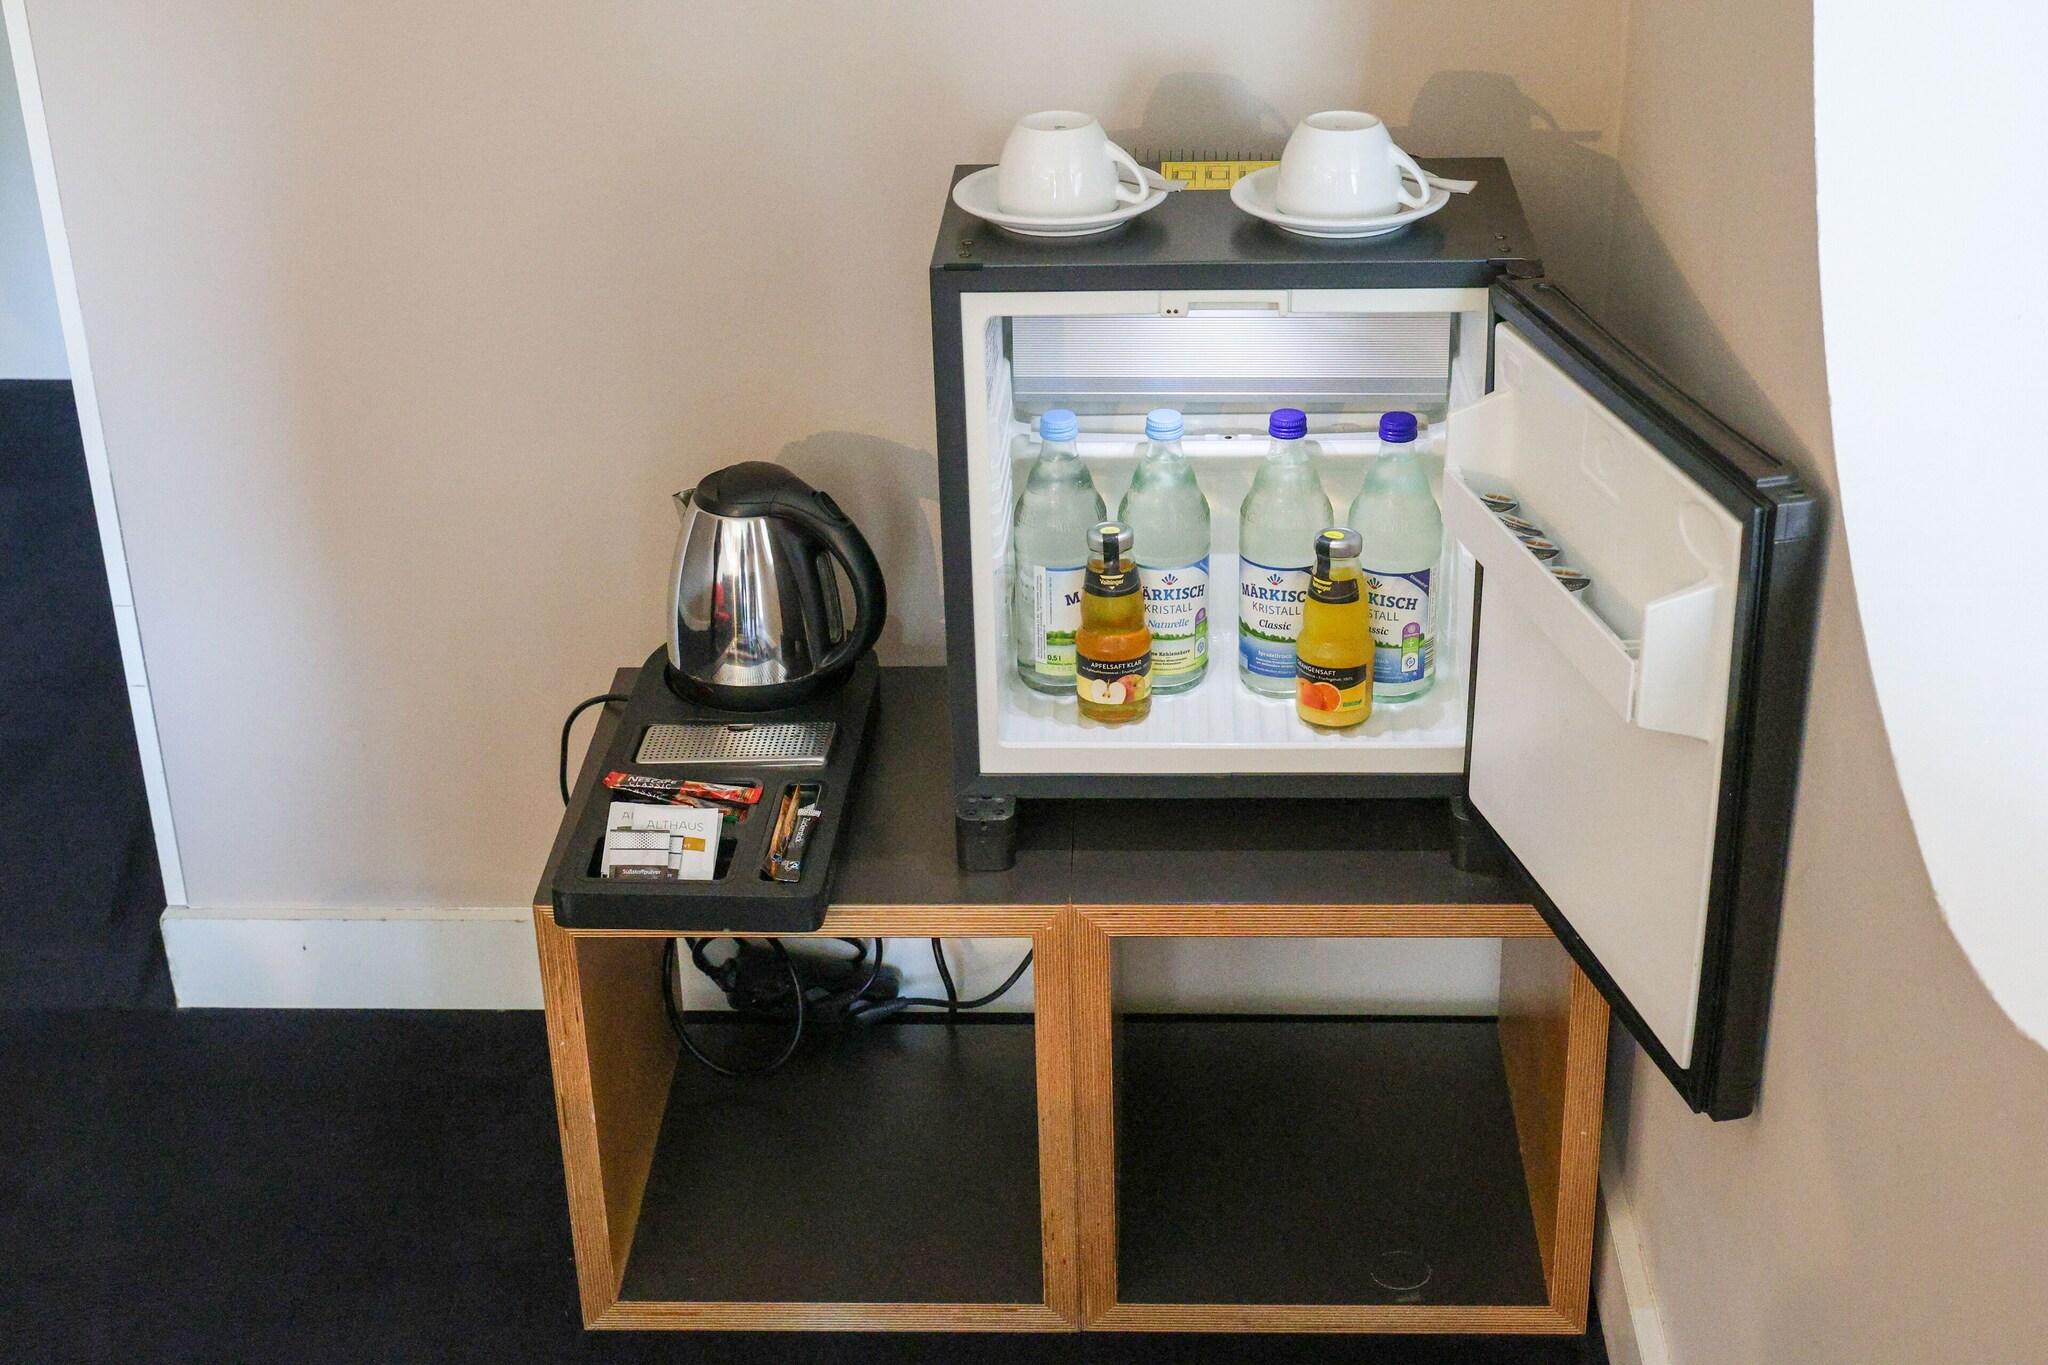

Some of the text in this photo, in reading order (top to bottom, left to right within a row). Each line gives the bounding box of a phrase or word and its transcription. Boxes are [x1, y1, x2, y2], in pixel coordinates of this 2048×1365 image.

[1142, 584, 1205, 601] ÄRKISCH
[1241, 583, 1307, 603] MÄRKISC
[1368, 592, 1418, 610] KISCH
[1145, 602, 1193, 615] KRISTALL
[1252, 601, 1301, 616] KRISTALL
[1148, 618, 1189, 629] Naturelle
[1259, 619, 1291, 630] Classic
[1090, 662, 1125, 670] APFELSAFT
[1127, 659, 1142, 668] KLAR
[629, 781, 672, 790] CLASSIC
[646, 819, 704, 832] ALTHAUS
